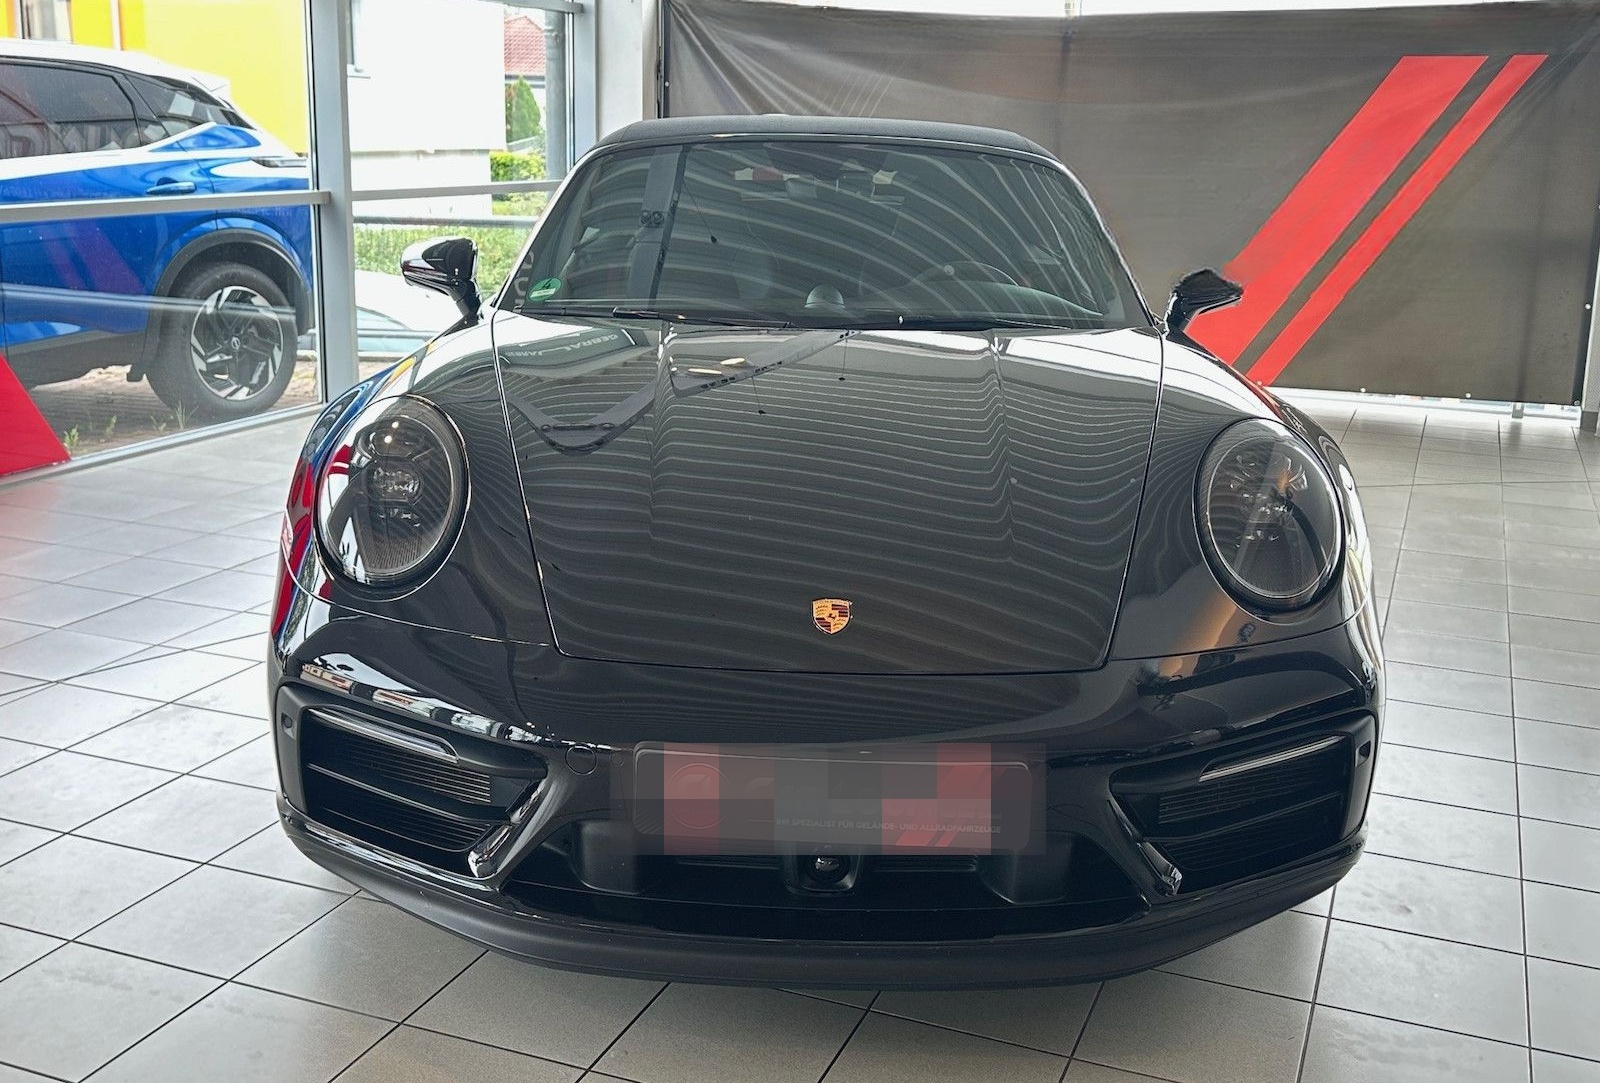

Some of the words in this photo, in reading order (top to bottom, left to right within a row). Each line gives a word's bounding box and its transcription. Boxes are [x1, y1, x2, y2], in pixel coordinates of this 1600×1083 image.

[541, 279, 552, 289] 4
[775, 818, 790, 826] IHR
[790, 818, 836, 828] SPEZIALIST
[838, 818, 855, 829] FÜR
[899, 822, 918, 831] UND
[919, 823, 1002, 834] ALLRADFAHRZEUGE
